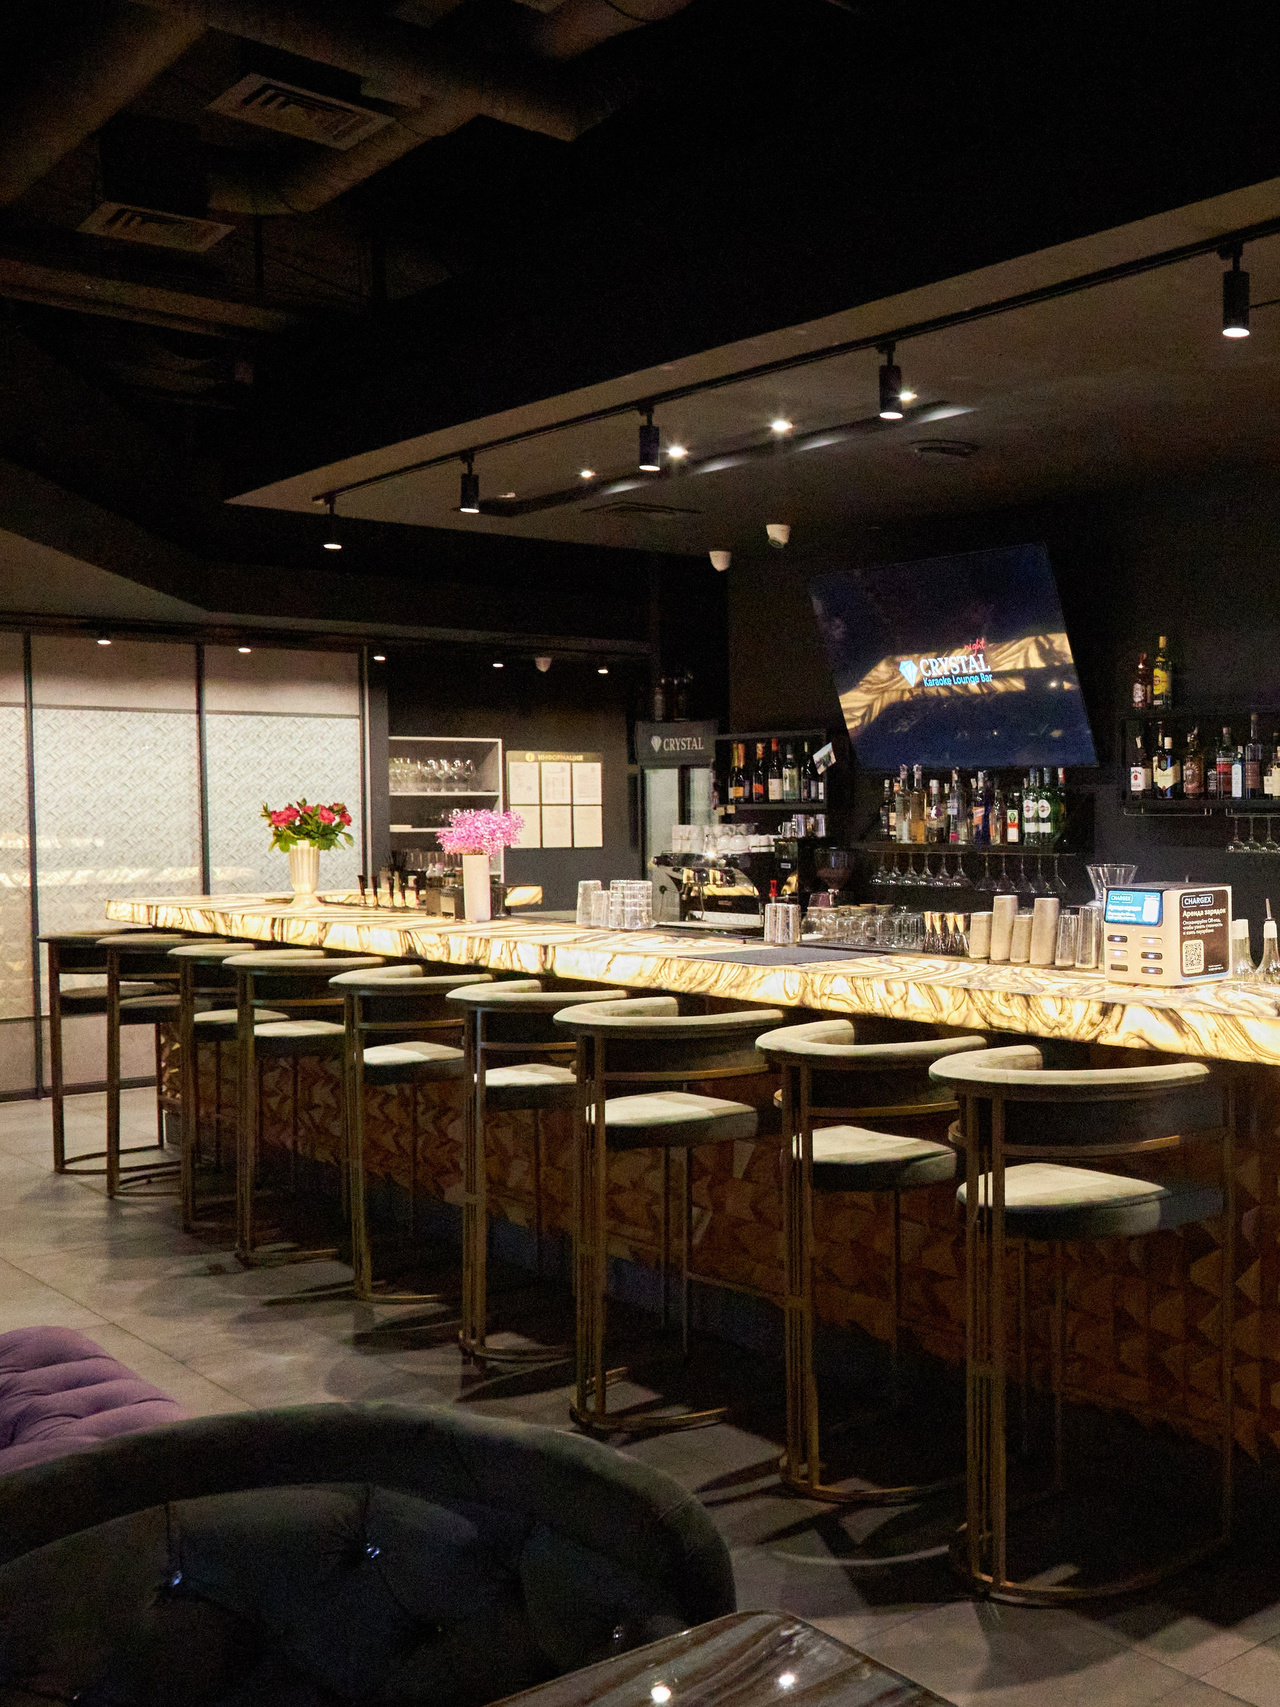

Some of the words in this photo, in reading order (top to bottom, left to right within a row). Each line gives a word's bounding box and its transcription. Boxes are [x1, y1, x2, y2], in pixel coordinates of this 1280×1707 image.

[964, 637, 985, 656] night
[919, 654, 991, 676] CRYSTAL
[923, 676, 952, 687] Karaoke
[952, 674, 980, 686] Lounge
[980, 672, 993, 683] Bar
[663, 737, 704, 751] CRYSTAL
[1184, 896, 1212, 905] CHARGEX
